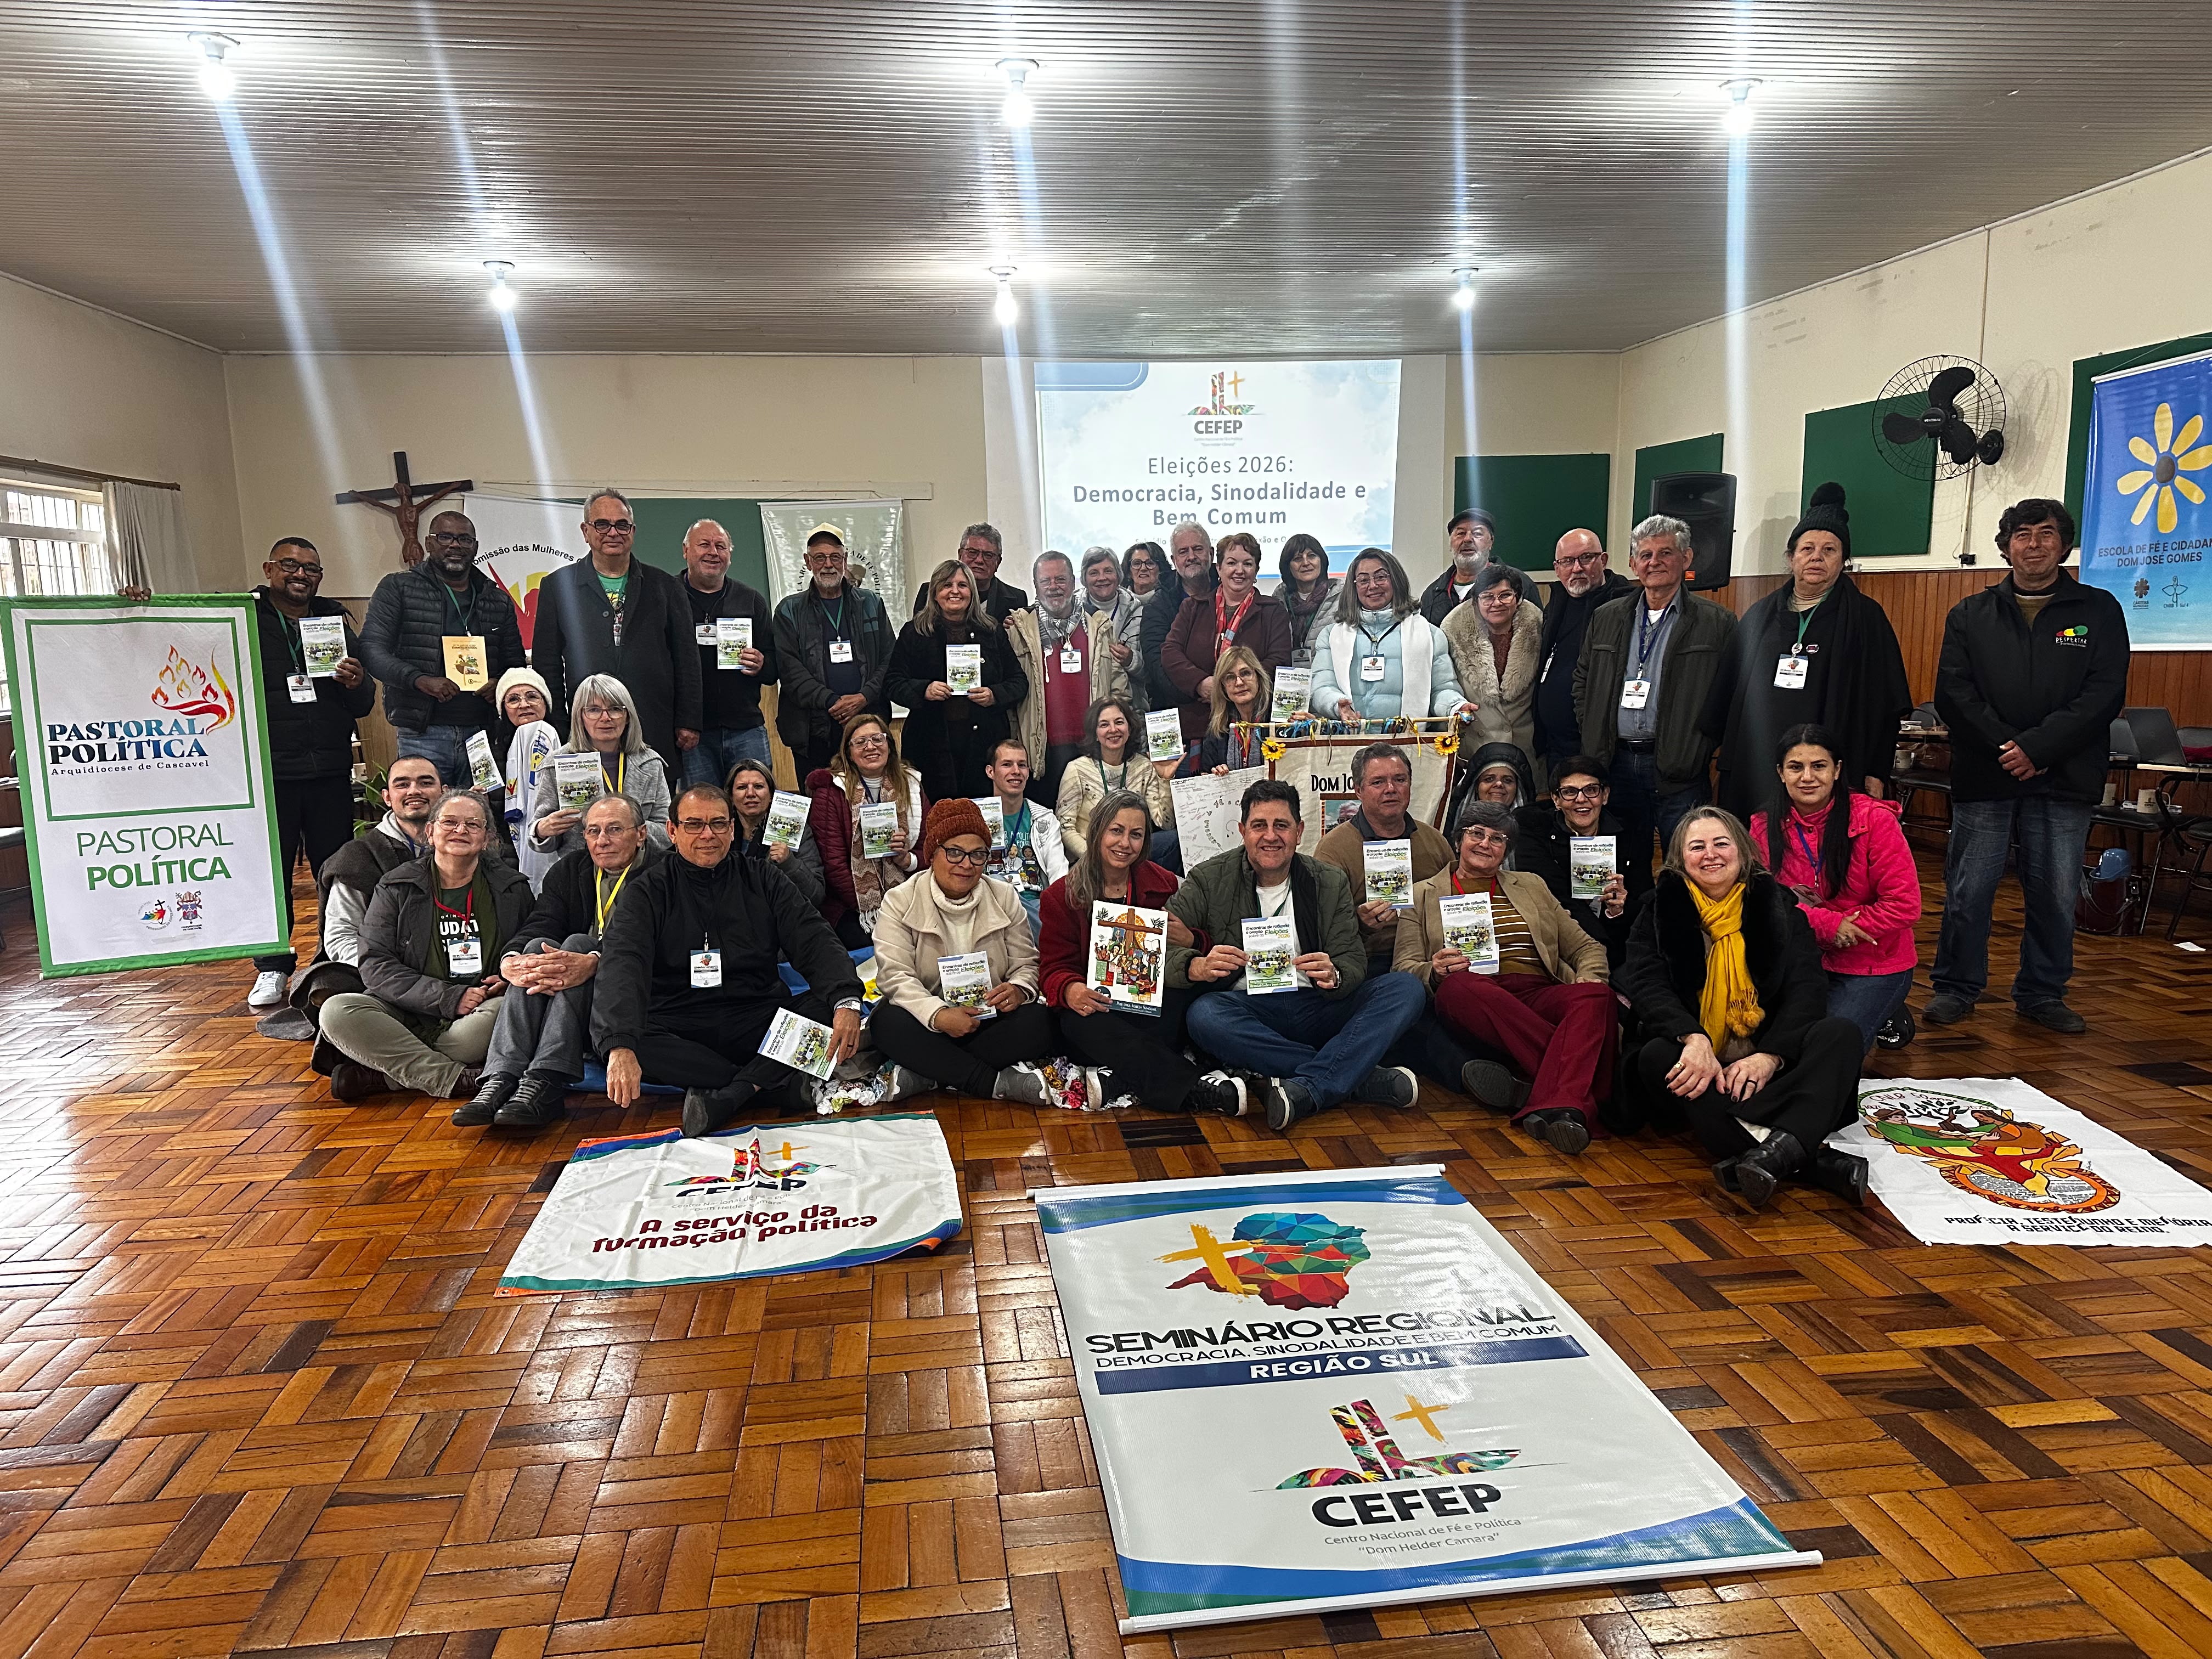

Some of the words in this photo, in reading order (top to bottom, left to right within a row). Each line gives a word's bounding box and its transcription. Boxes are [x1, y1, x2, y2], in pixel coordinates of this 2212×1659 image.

[1194, 420, 1243, 434] CEFEP
[1149, 456, 1231, 477] Eleições
[1239, 456, 1293, 472] 2026:
[1074, 484, 1203, 504] Democracia,
[1211, 481, 1346, 500] Sinodalidade
[1355, 485, 1366, 498] e
[1154, 509, 1196, 525] Bem
[1208, 509, 1286, 524] Comum
[472, 545, 510, 565] omissão
[512, 544, 529, 552] das
[532, 544, 574, 562] Mulheres
[856, 553, 867, 563] DE
[2098, 545, 2133, 557] ESCOLA
[2135, 544, 2147, 554] DE
[2149, 540, 2160, 552] FÉ
[2163, 542, 2169, 551] E
[2117, 557, 2138, 567] DOM
[2140, 552, 2164, 566] JOSÉ
[2166, 551, 2202, 563] GOMES
[47, 718, 204, 741] PASTORAL
[48, 736, 208, 764] POLÍTICA
[51, 766, 133, 776] Arquidiocese
[156, 760, 209, 769] Cascavel
[1311, 775, 1339, 792] DOM
[77, 823, 234, 856] PASTORAL
[87, 855, 232, 890] POLÍTICA
[780, 1017, 793, 1040] Eleições
[639, 1219, 662, 1234] A
[673, 1211, 788, 1231] serviço
[800, 1204, 837, 1219] da
[758, 1215, 878, 1242] política
[1085, 1320, 1324, 1353] SEMINÁRIO
[1328, 1304, 1555, 1334] REGIONAL
[1096, 1349, 1250, 1369] DEMOCRACIA,
[1254, 1332, 1409, 1356] SINODALIDADE
[1413, 1331, 1424, 1342] E
[1426, 1328, 1478, 1342] BEM
[1480, 1323, 1561, 1339] COMUM
[1250, 1353, 1370, 1379] REGIÃO
[1379, 1351, 1438, 1368] SUL
[1312, 1483, 1501, 1527] CEFEP
[1324, 1534, 1367, 1544] Centro
[1370, 1528, 1427, 1541] Nacional
[1429, 1525, 1446, 1534] de
[1447, 1523, 1463, 1533] Fé
[1475, 1517, 1521, 1530] Política
[1399, 1540, 1442, 1551] Helder
